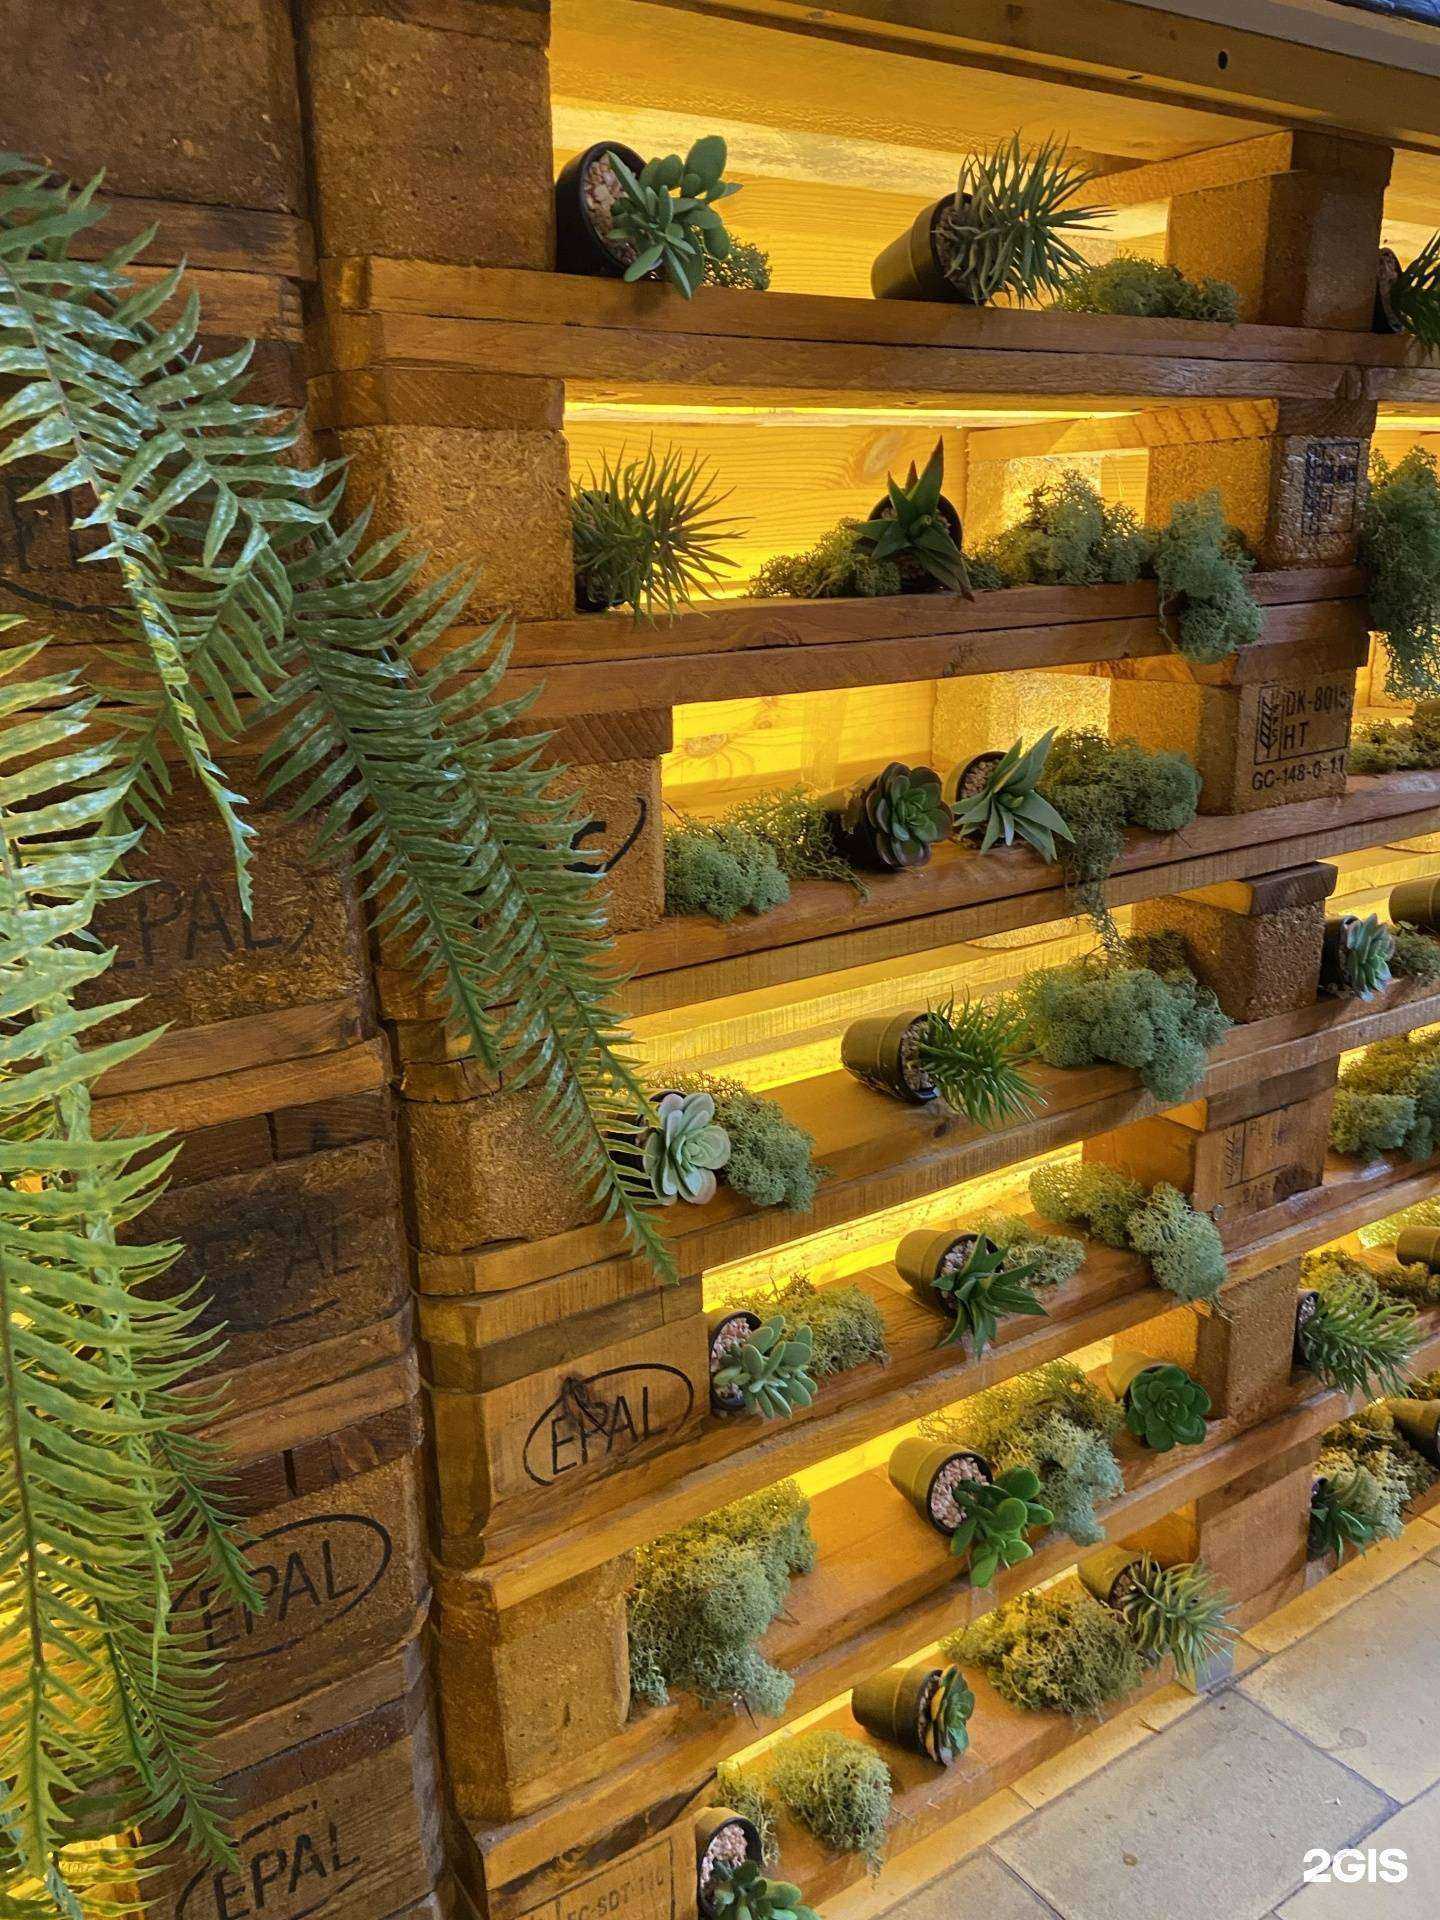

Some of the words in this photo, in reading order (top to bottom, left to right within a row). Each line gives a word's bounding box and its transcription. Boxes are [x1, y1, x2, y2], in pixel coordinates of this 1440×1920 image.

[1283, 721, 1309, 750] HT
[551, 1386, 668, 1475] EPAL
[201, 1540, 358, 1650] EPAL
[213, 1822, 361, 1920] EPAL
